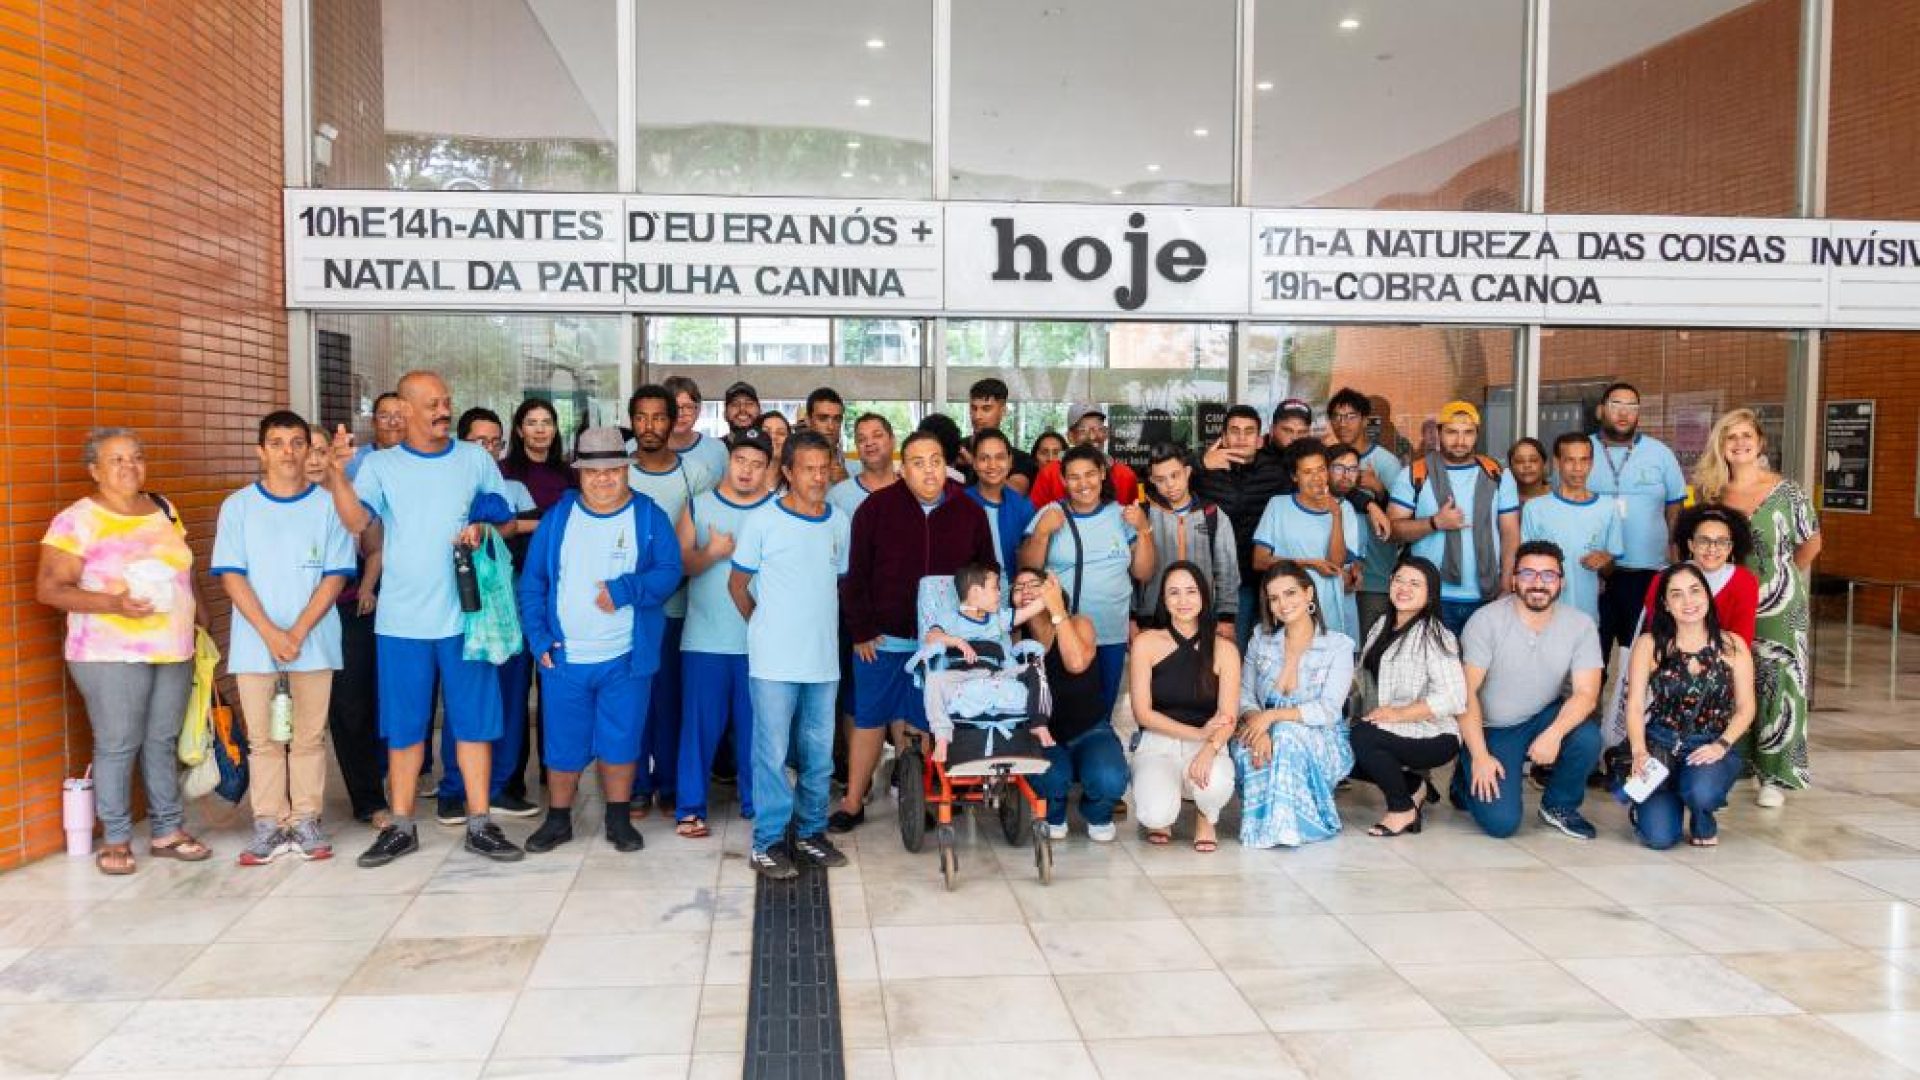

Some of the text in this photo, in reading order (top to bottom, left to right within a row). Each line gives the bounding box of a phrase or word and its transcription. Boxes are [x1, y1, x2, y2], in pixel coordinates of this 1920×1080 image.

[723, 213, 803, 245] ERA
[809, 206, 899, 246] NÓS
[990, 212, 1208, 312] hoje
[1366, 229, 1560, 260] NATUREZA
[1577, 231, 1646, 262] DAS
[1658, 232, 1787, 264] COISAS
[323, 258, 906, 298] NATAL DA PATRULHA CANINA
[1471, 273, 1603, 304] CANOA
